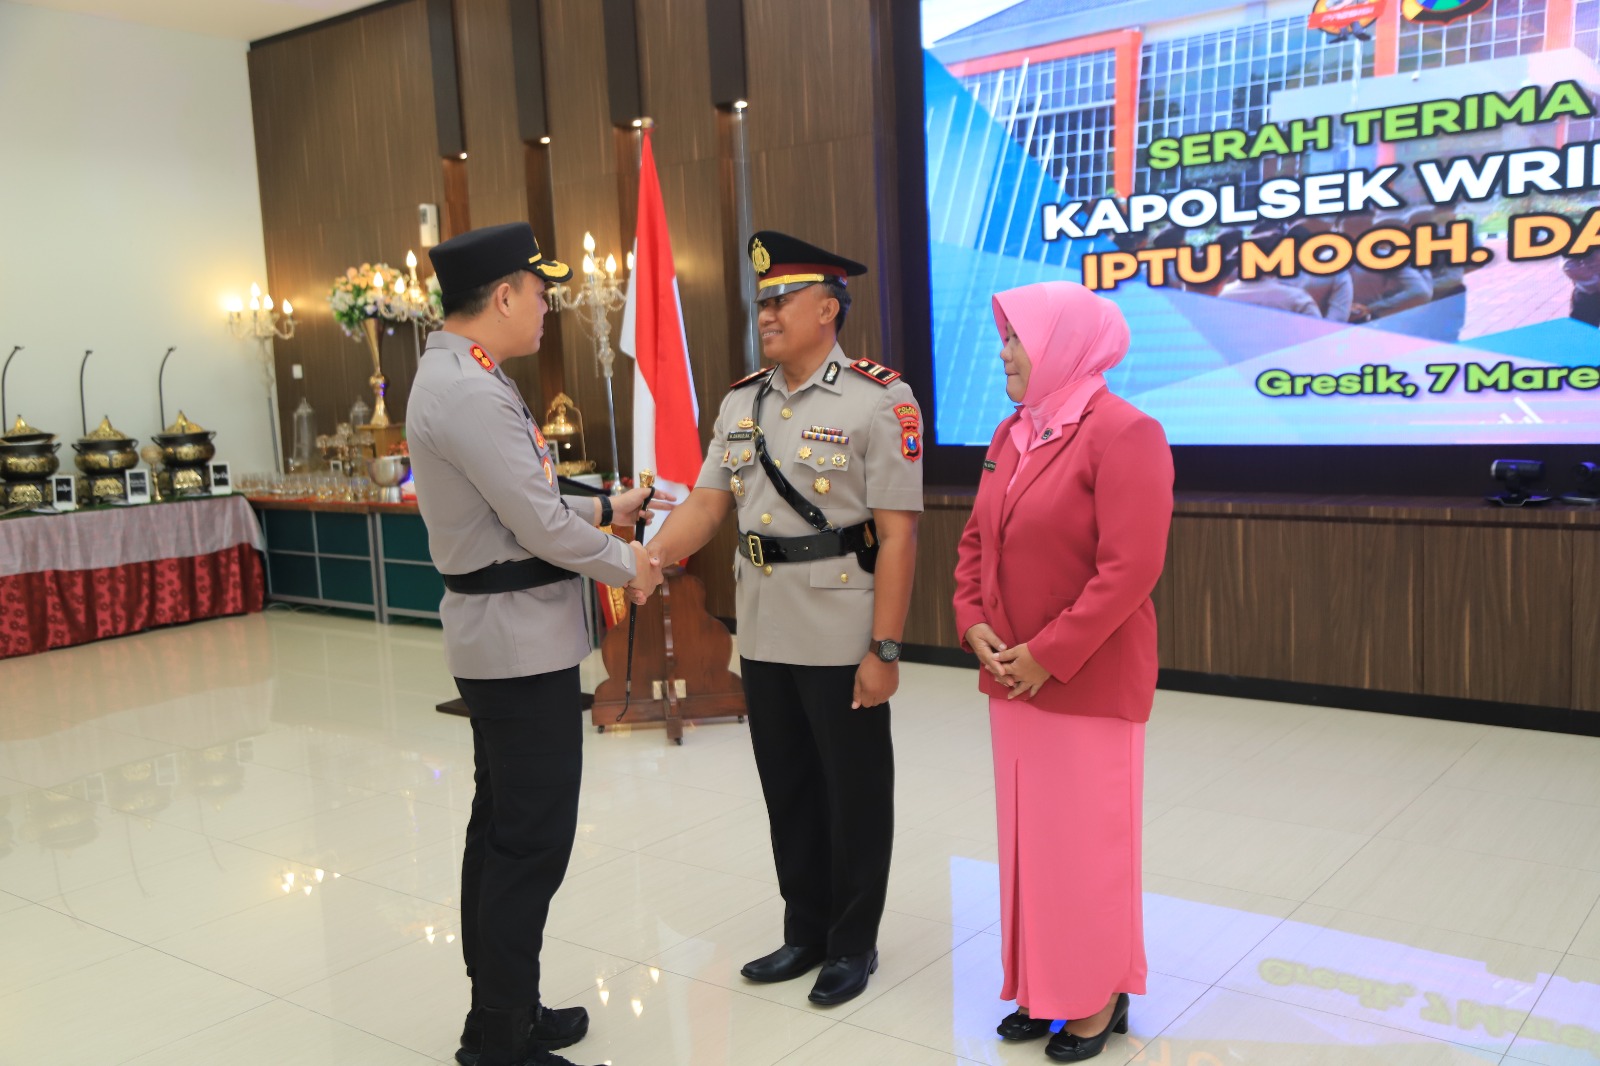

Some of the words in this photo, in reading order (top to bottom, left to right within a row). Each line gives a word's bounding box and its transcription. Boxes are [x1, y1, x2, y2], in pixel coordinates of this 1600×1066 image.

[1149, 116, 1329, 170] SERAH
[1344, 83, 1591, 144] TERIMA
[1042, 166, 1400, 241] KAPOLSEK
[1083, 244, 1222, 291] IPTU
[1241, 222, 1489, 280] MOCH.
[1257, 365, 1417, 397] Gresik,
[1428, 364, 1458, 392] 7
[1466, 362, 1600, 392] Mare
